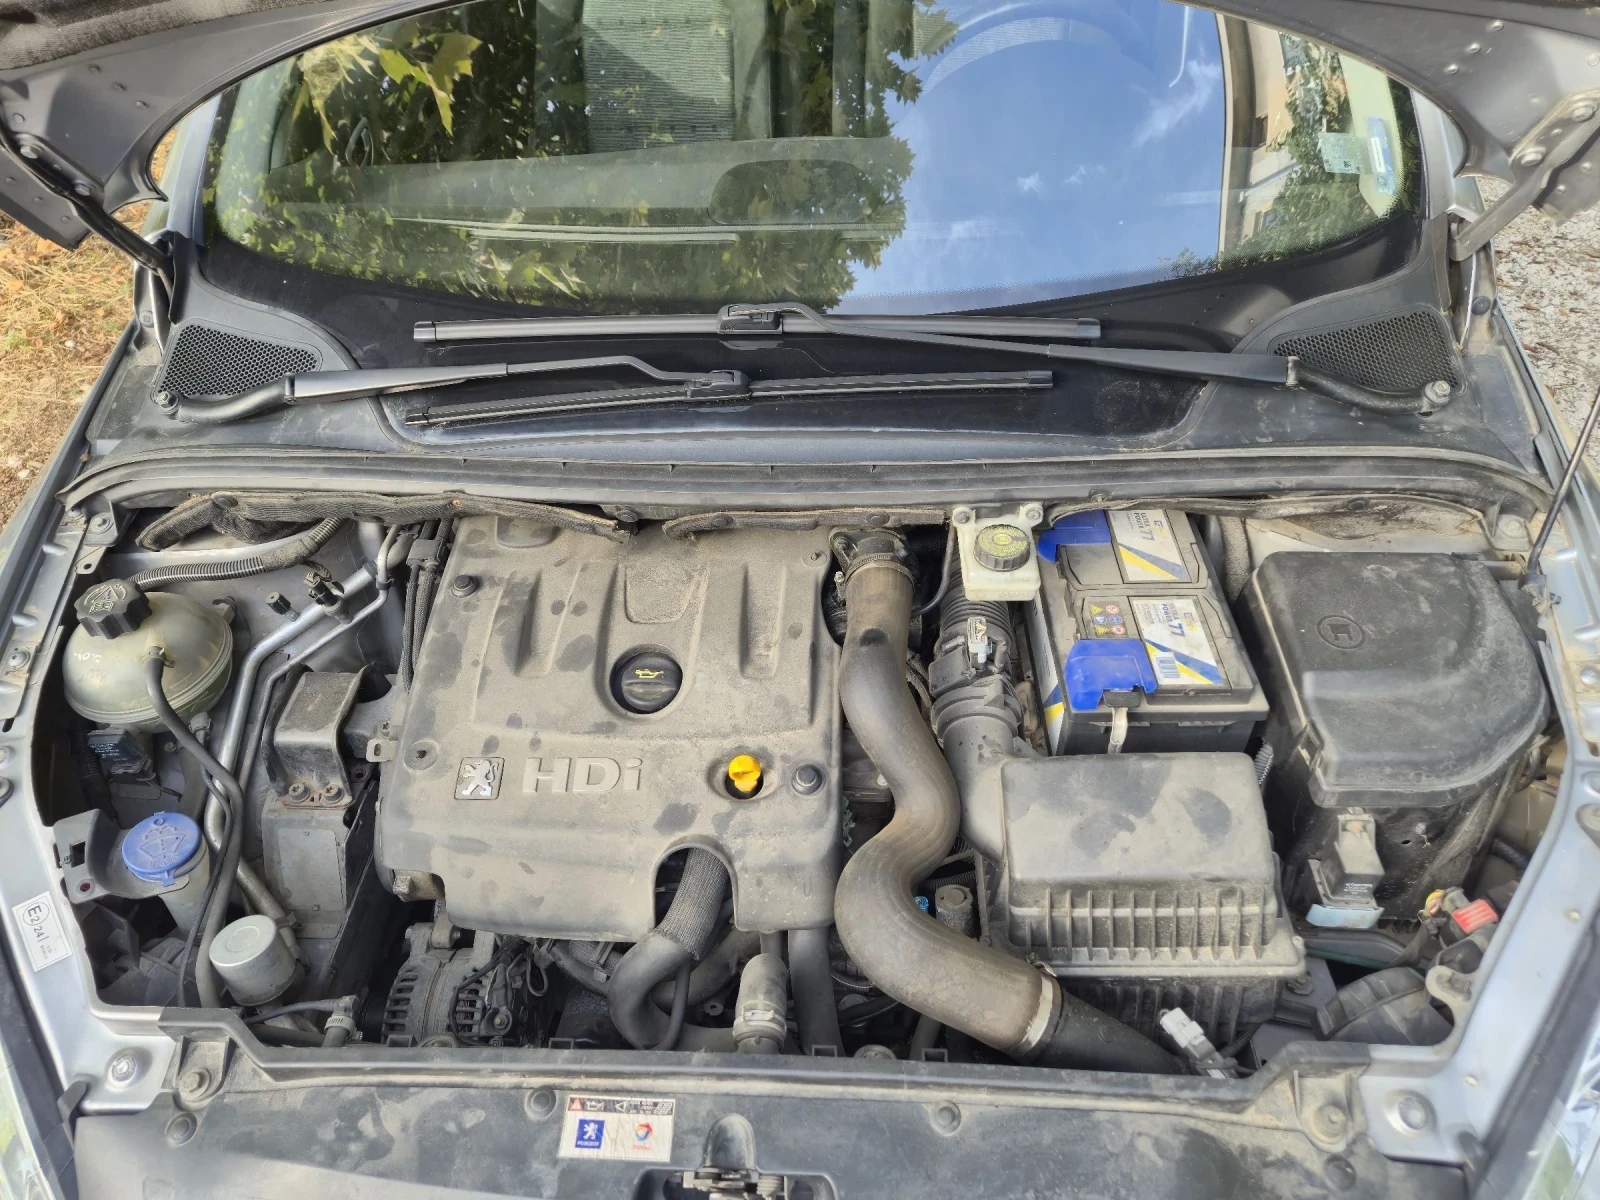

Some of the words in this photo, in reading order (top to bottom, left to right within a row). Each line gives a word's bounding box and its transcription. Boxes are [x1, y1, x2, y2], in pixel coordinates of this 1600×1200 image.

[1140, 530, 1155, 541] 77
[1161, 603, 1173, 623] POWER
[1168, 622, 1186, 637] 77
[521, 756, 643, 793] HDi
